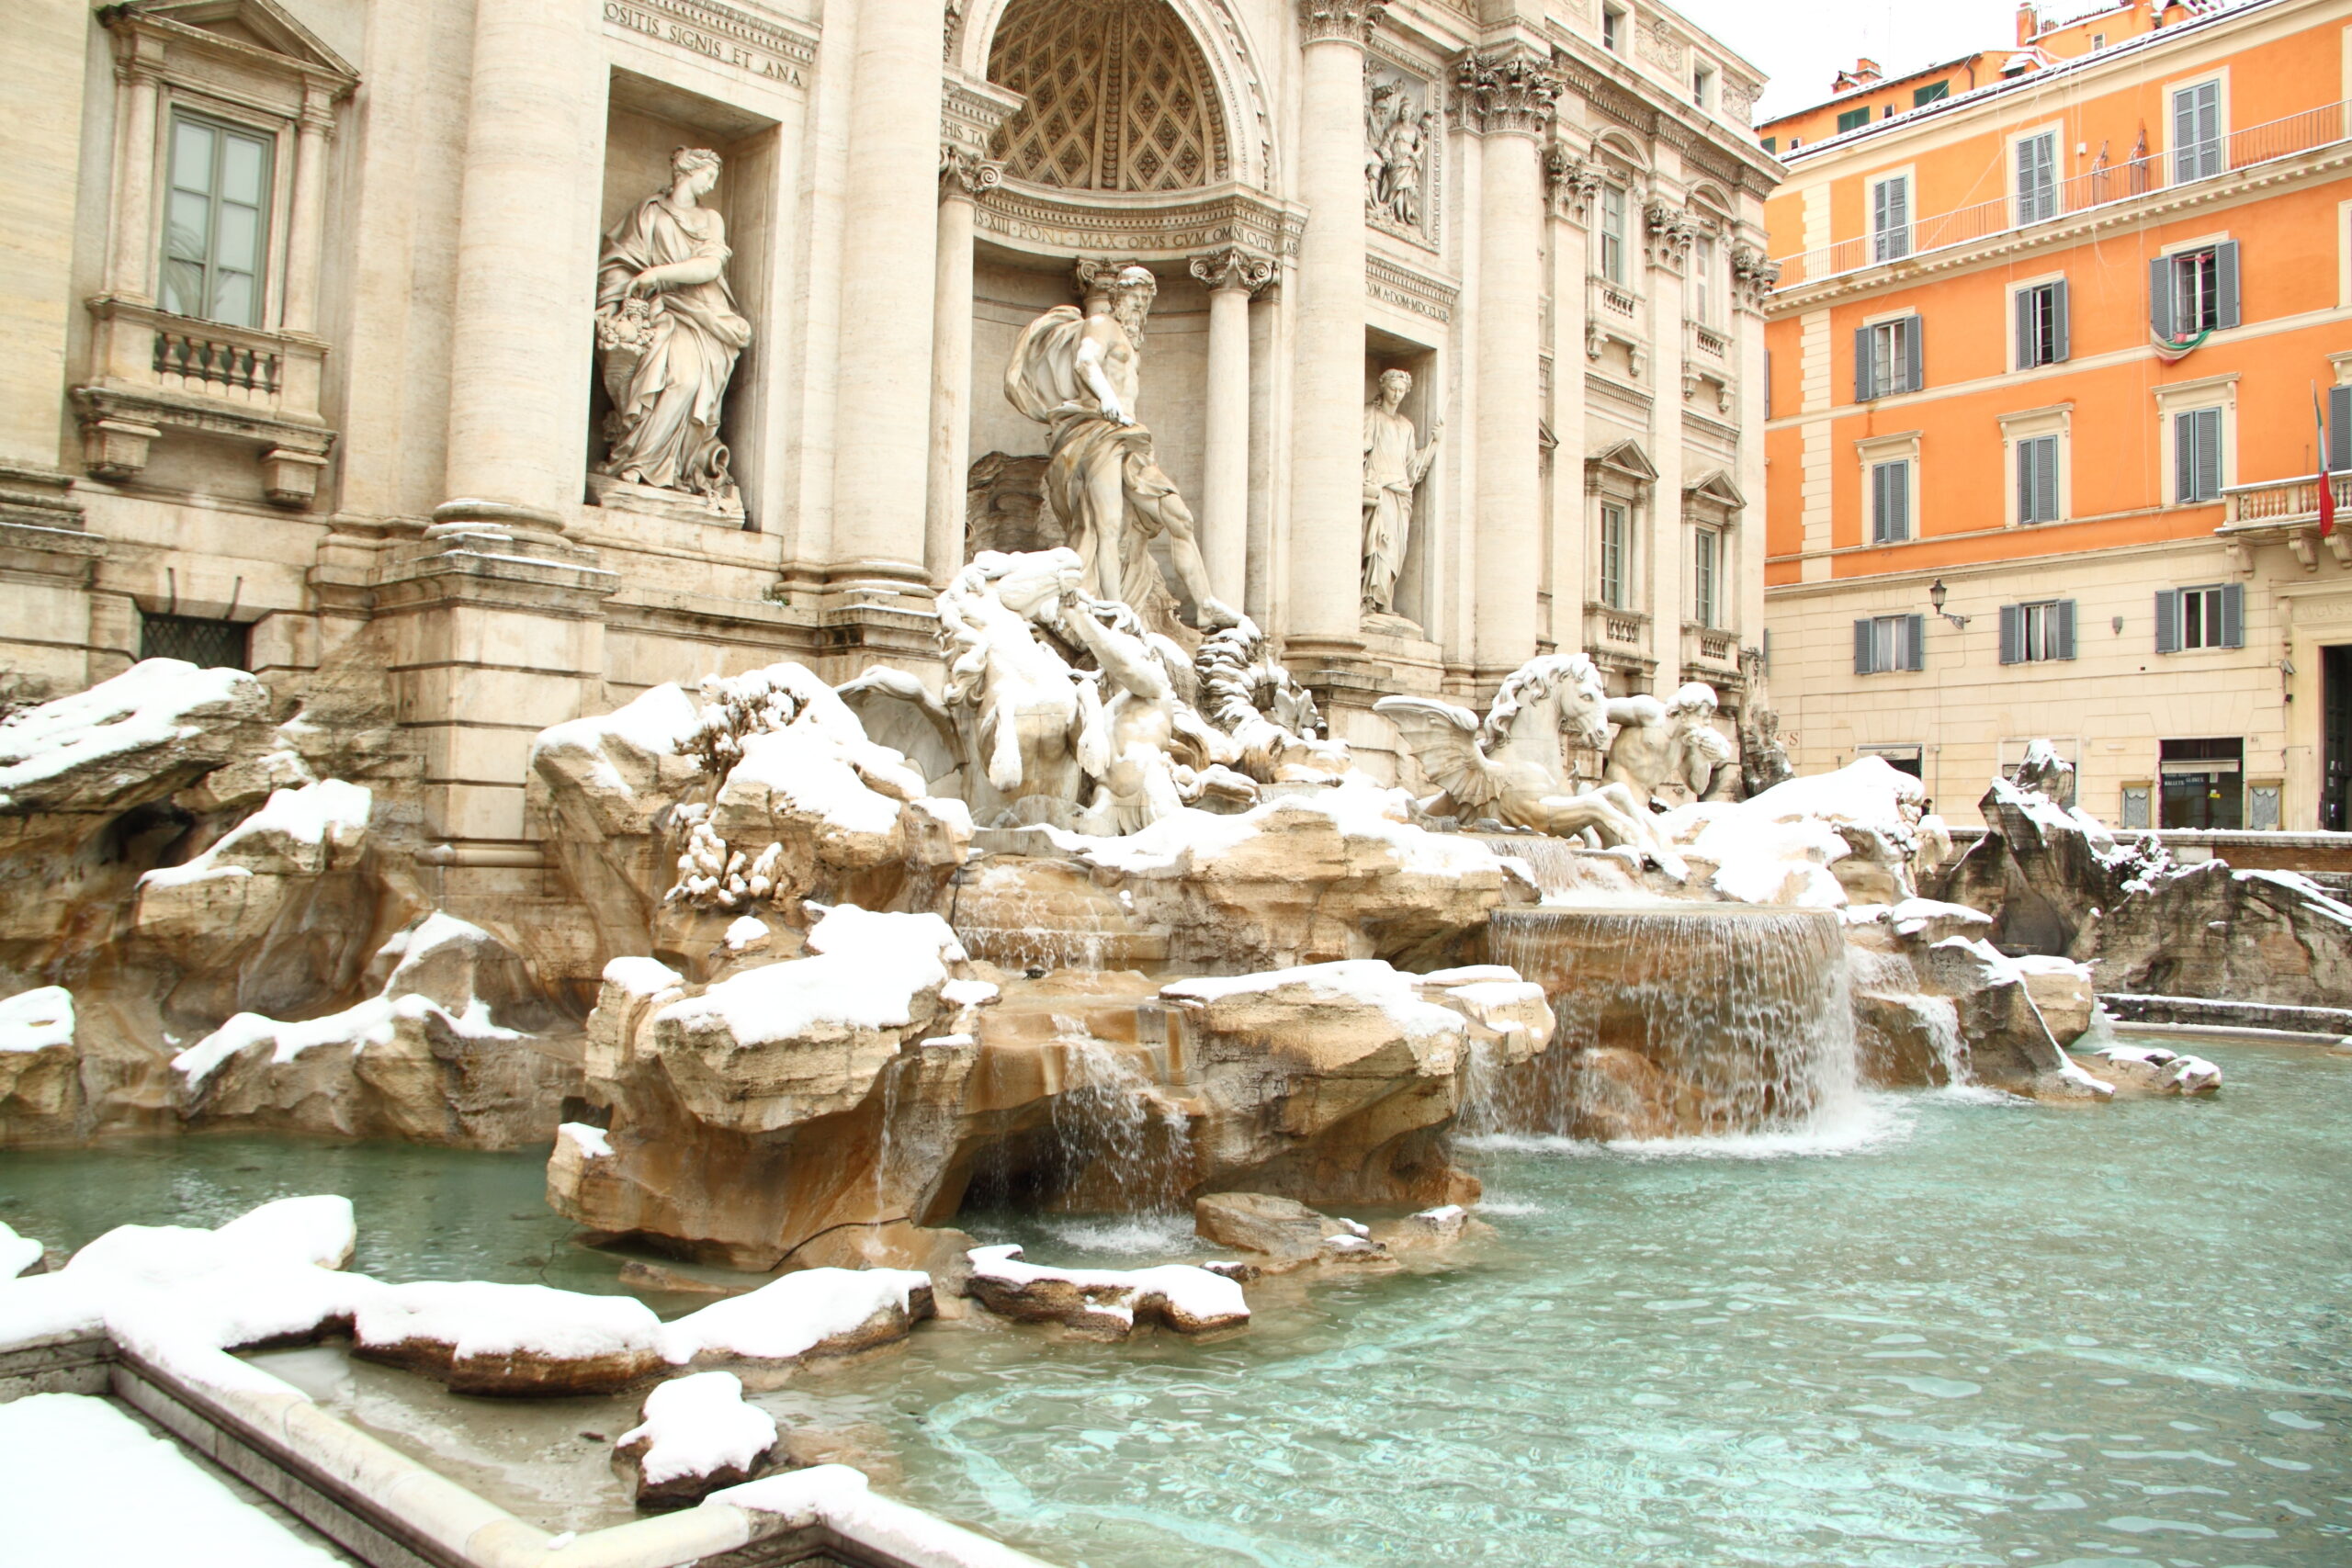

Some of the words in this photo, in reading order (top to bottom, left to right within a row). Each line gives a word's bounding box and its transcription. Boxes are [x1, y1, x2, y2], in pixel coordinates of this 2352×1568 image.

[668, 25, 722, 58] SIGNIS
[732, 46, 753, 69] ET
[763, 61, 802, 87] ANA
[968, 128, 986, 148] TA
[1127, 234, 1166, 249] OPVS
[1172, 231, 1206, 247] CVM
[1213, 225, 1244, 241] OMNI
